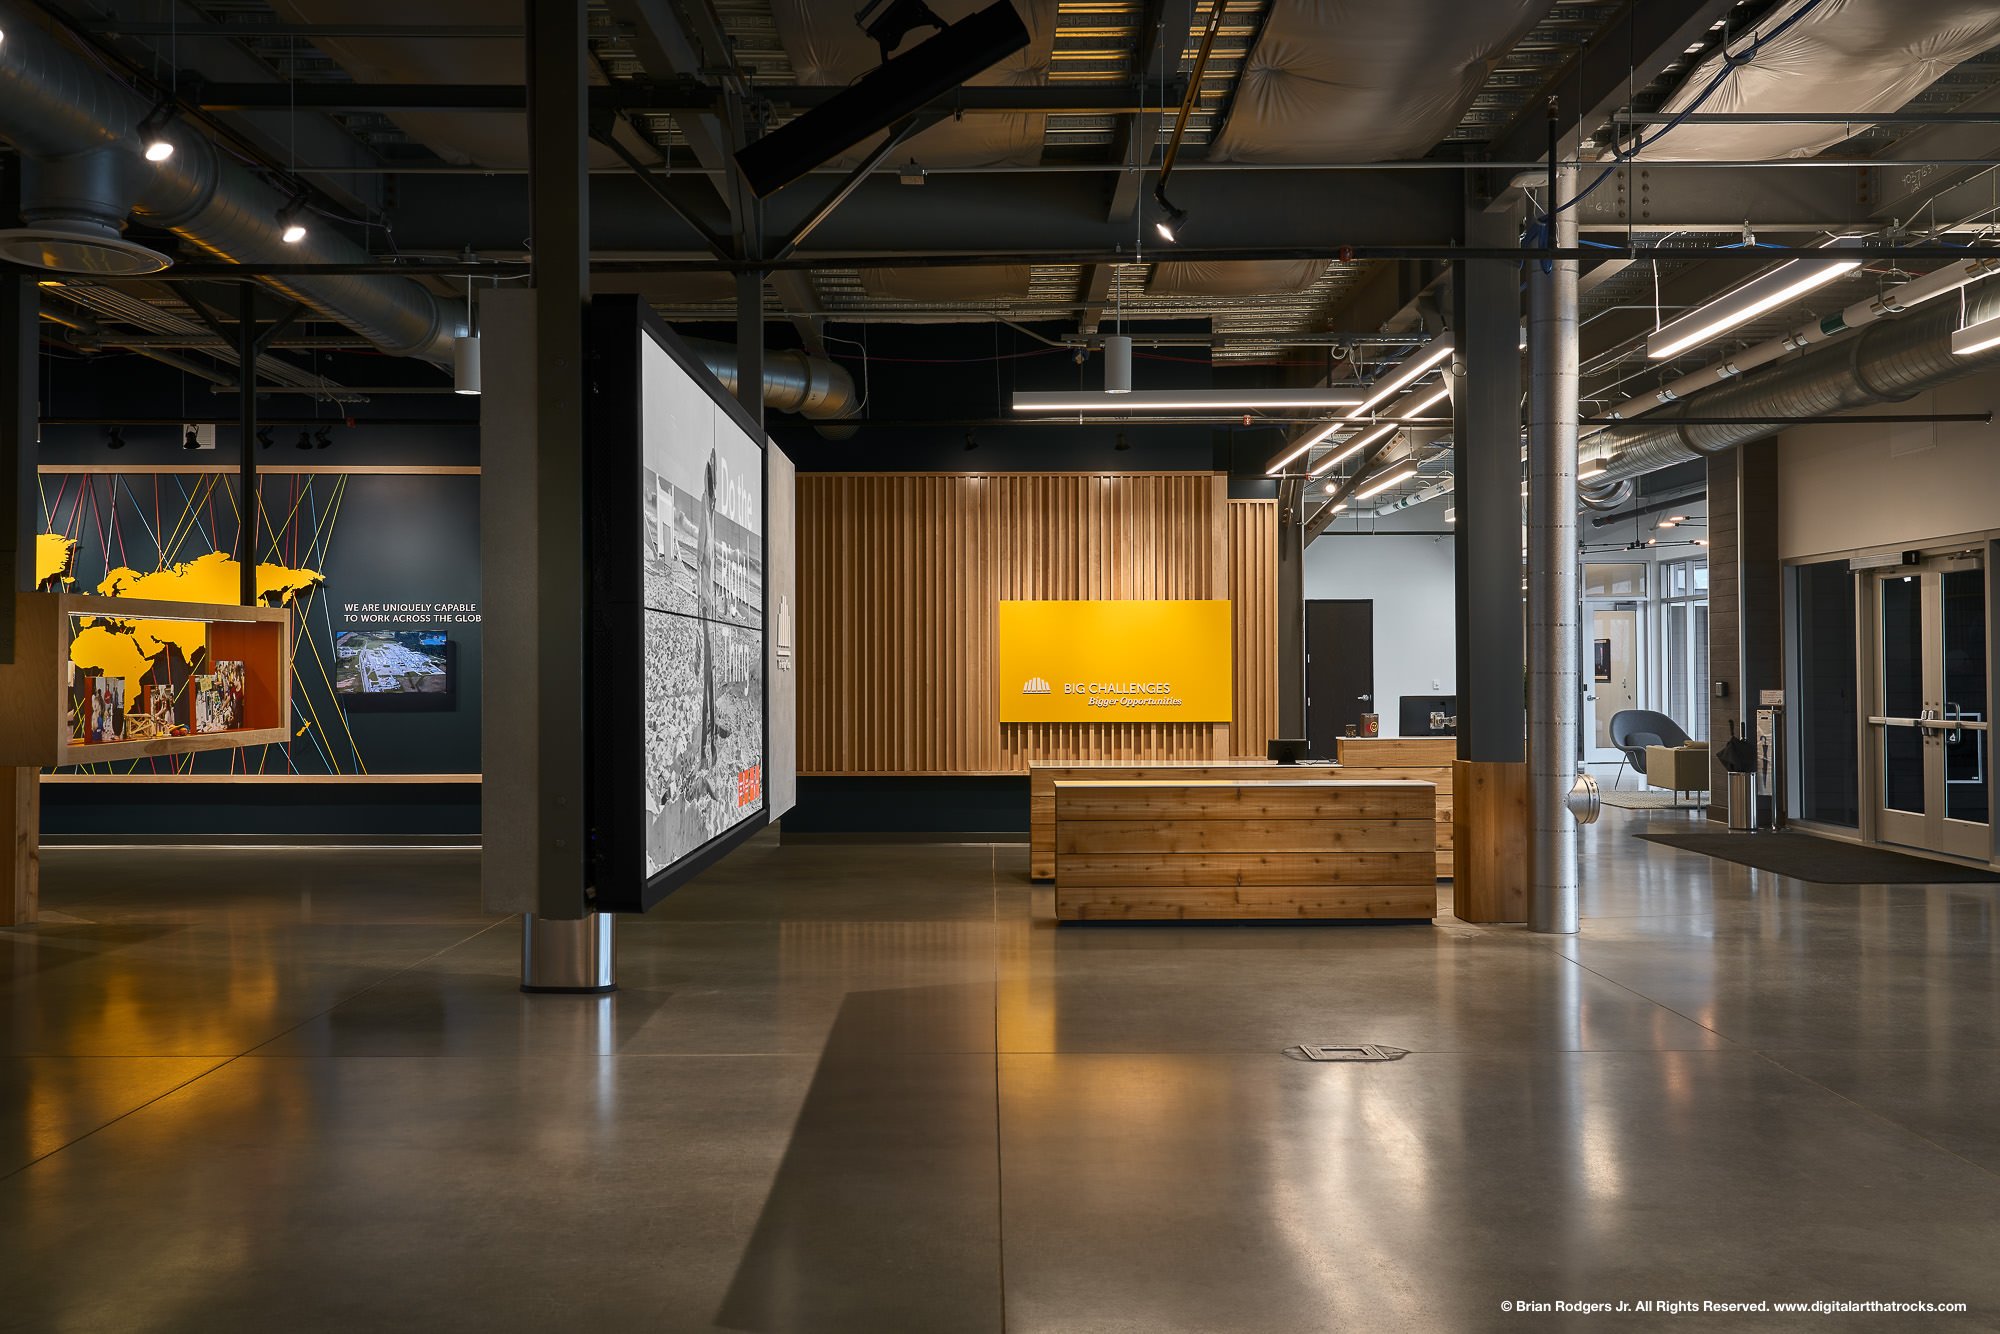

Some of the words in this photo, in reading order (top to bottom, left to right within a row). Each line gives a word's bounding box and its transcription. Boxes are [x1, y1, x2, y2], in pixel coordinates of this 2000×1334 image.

[721, 456, 736, 521] Do
[738, 472, 753, 532] the
[721, 541, 747, 618] Right
[344, 603, 359, 612] WE
[361, 603, 380, 612] ARE
[382, 603, 432, 612] UNIQUELY
[433, 603, 476, 612] CAPABLE
[344, 614, 359, 623] TO
[360, 614, 391, 623] WORK
[392, 614, 431, 623] ACROSS
[433, 614, 453, 623] THE
[722, 626, 750, 697] Thing
[1064, 683, 1086, 694] BIG
[1089, 683, 1171, 694] CHALLENGES
[1088, 696, 1119, 707] Bigger
[1120, 696, 1182, 707] Opportunities
